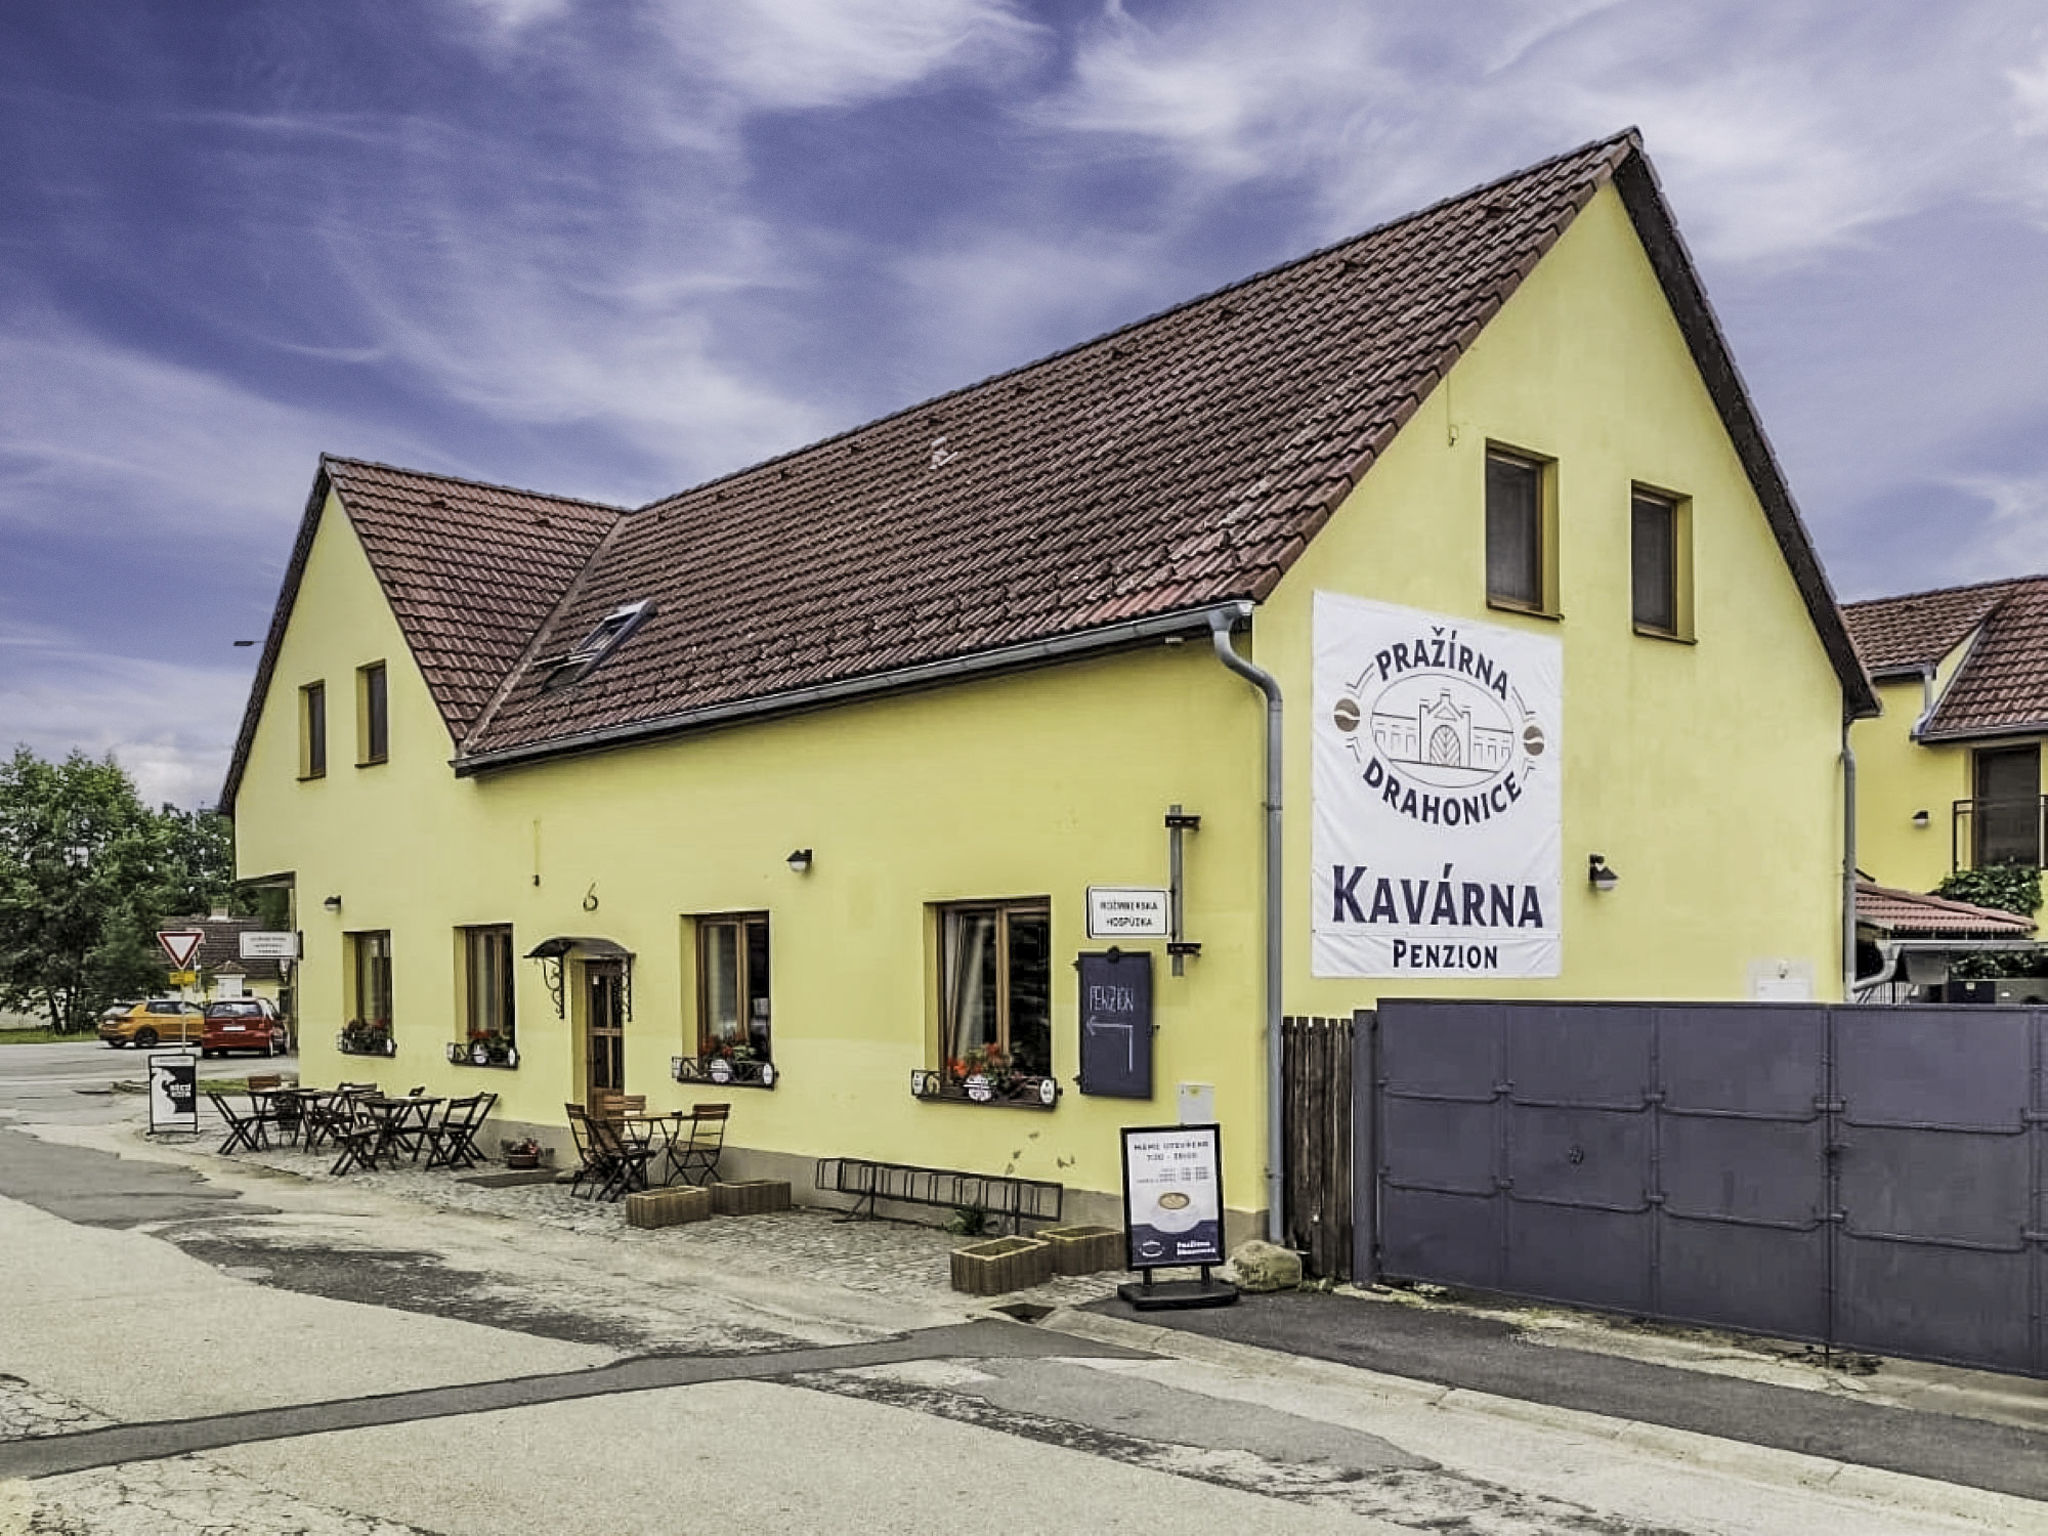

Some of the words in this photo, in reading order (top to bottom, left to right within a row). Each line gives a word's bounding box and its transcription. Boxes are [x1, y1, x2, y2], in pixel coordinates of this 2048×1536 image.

[1375, 626, 1509, 700] PRAŽÍRNA
[1362, 757, 1522, 827] DRAHONICE
[582, 882, 599, 912] 6
[1332, 862, 1544, 929] KAVÁRNA
[1392, 939, 1498, 970] PENZION
